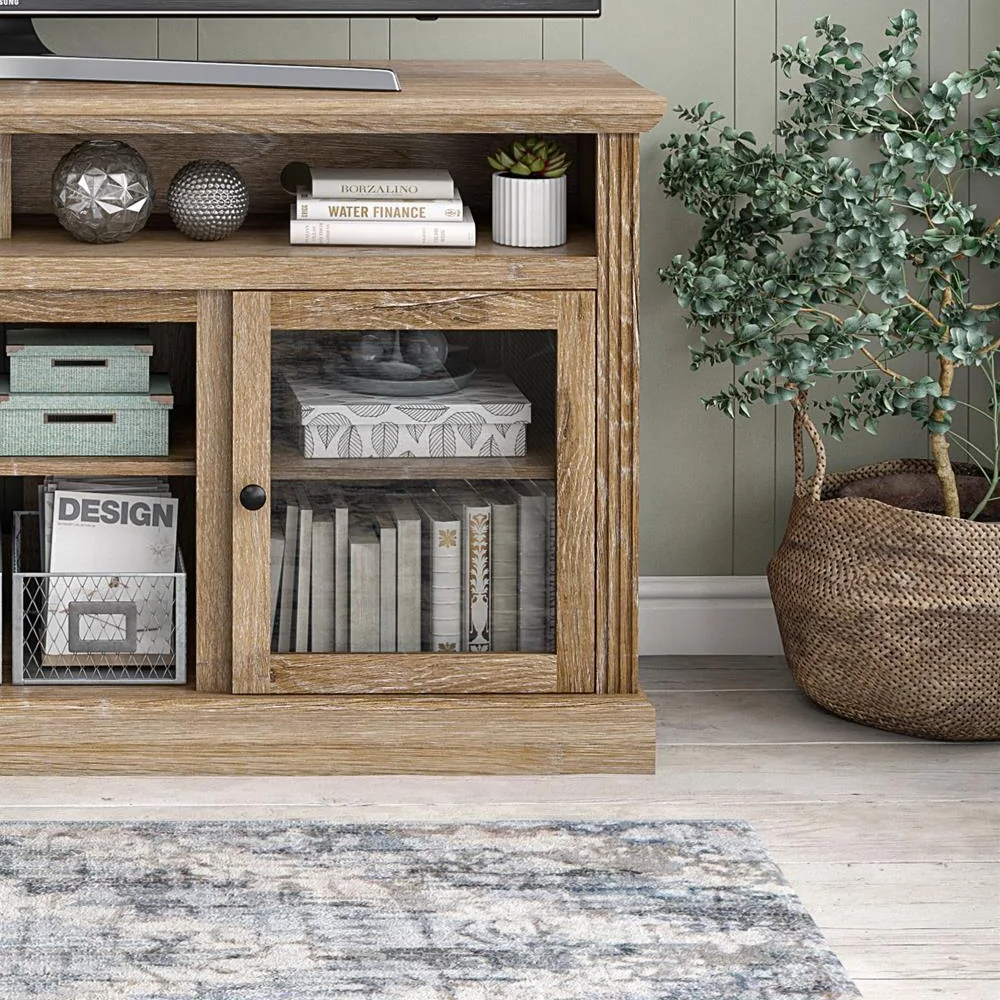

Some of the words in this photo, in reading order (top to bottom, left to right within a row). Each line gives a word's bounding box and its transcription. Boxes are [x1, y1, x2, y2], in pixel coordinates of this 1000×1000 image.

[341, 184, 419, 194] BORZALINO
[328, 205, 369, 218] WATER
[373, 206, 426, 219] FINANCE
[58, 497, 174, 528] DESIGN
